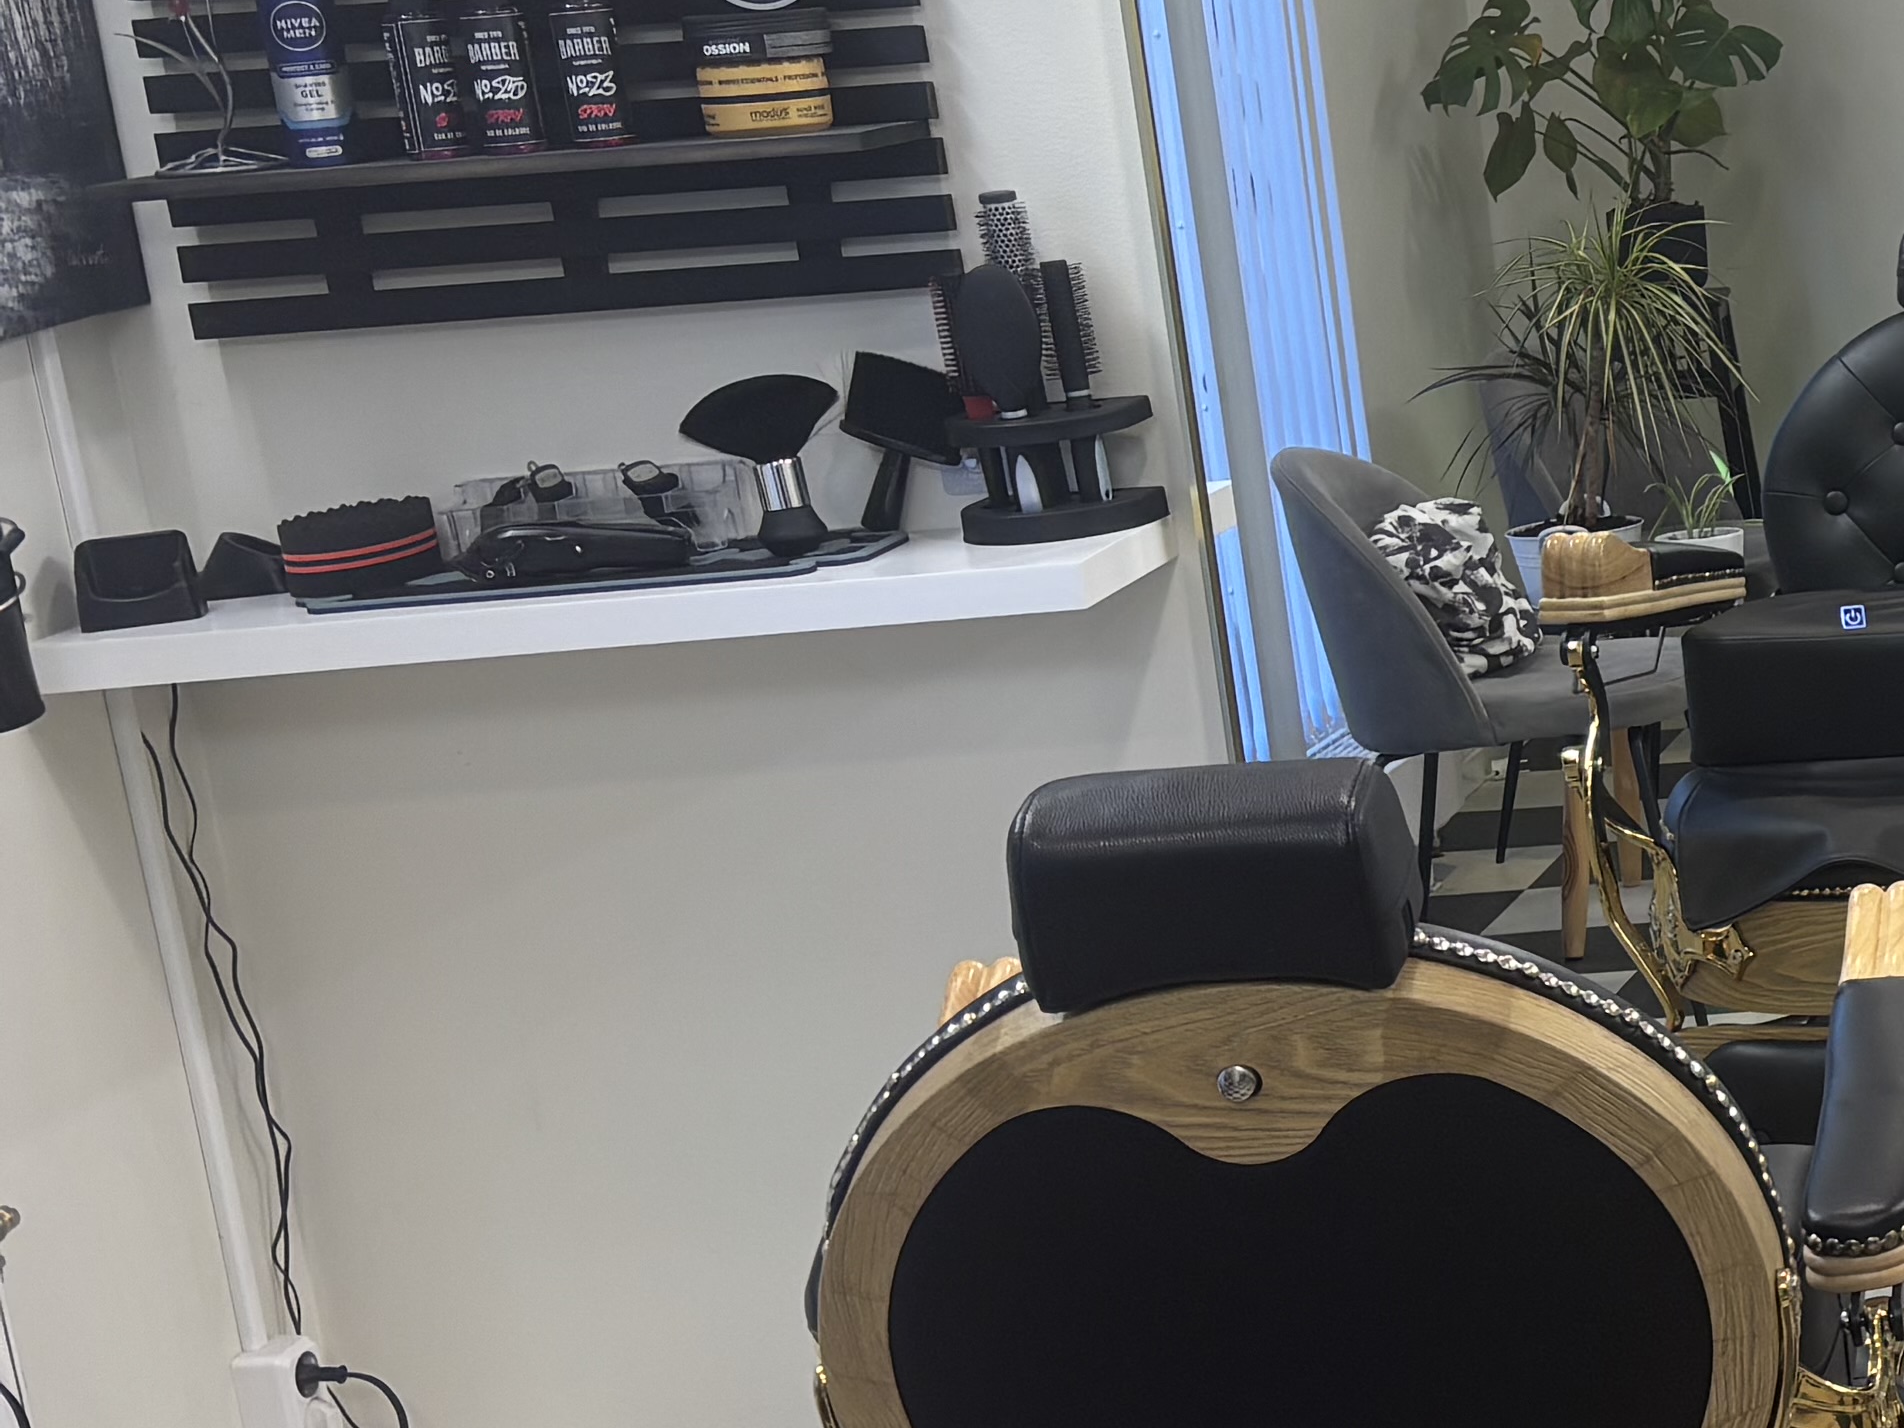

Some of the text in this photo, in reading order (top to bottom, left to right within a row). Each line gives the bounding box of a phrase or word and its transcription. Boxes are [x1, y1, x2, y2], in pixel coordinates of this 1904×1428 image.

[276, 17, 320, 30] NIVEA
[283, 28, 316, 40] MEN
[467, 40, 519, 64] BARBER
[558, 36, 611, 60] BARBER
[703, 42, 750, 56] OSSION
[301, 89, 323, 98] GEL
